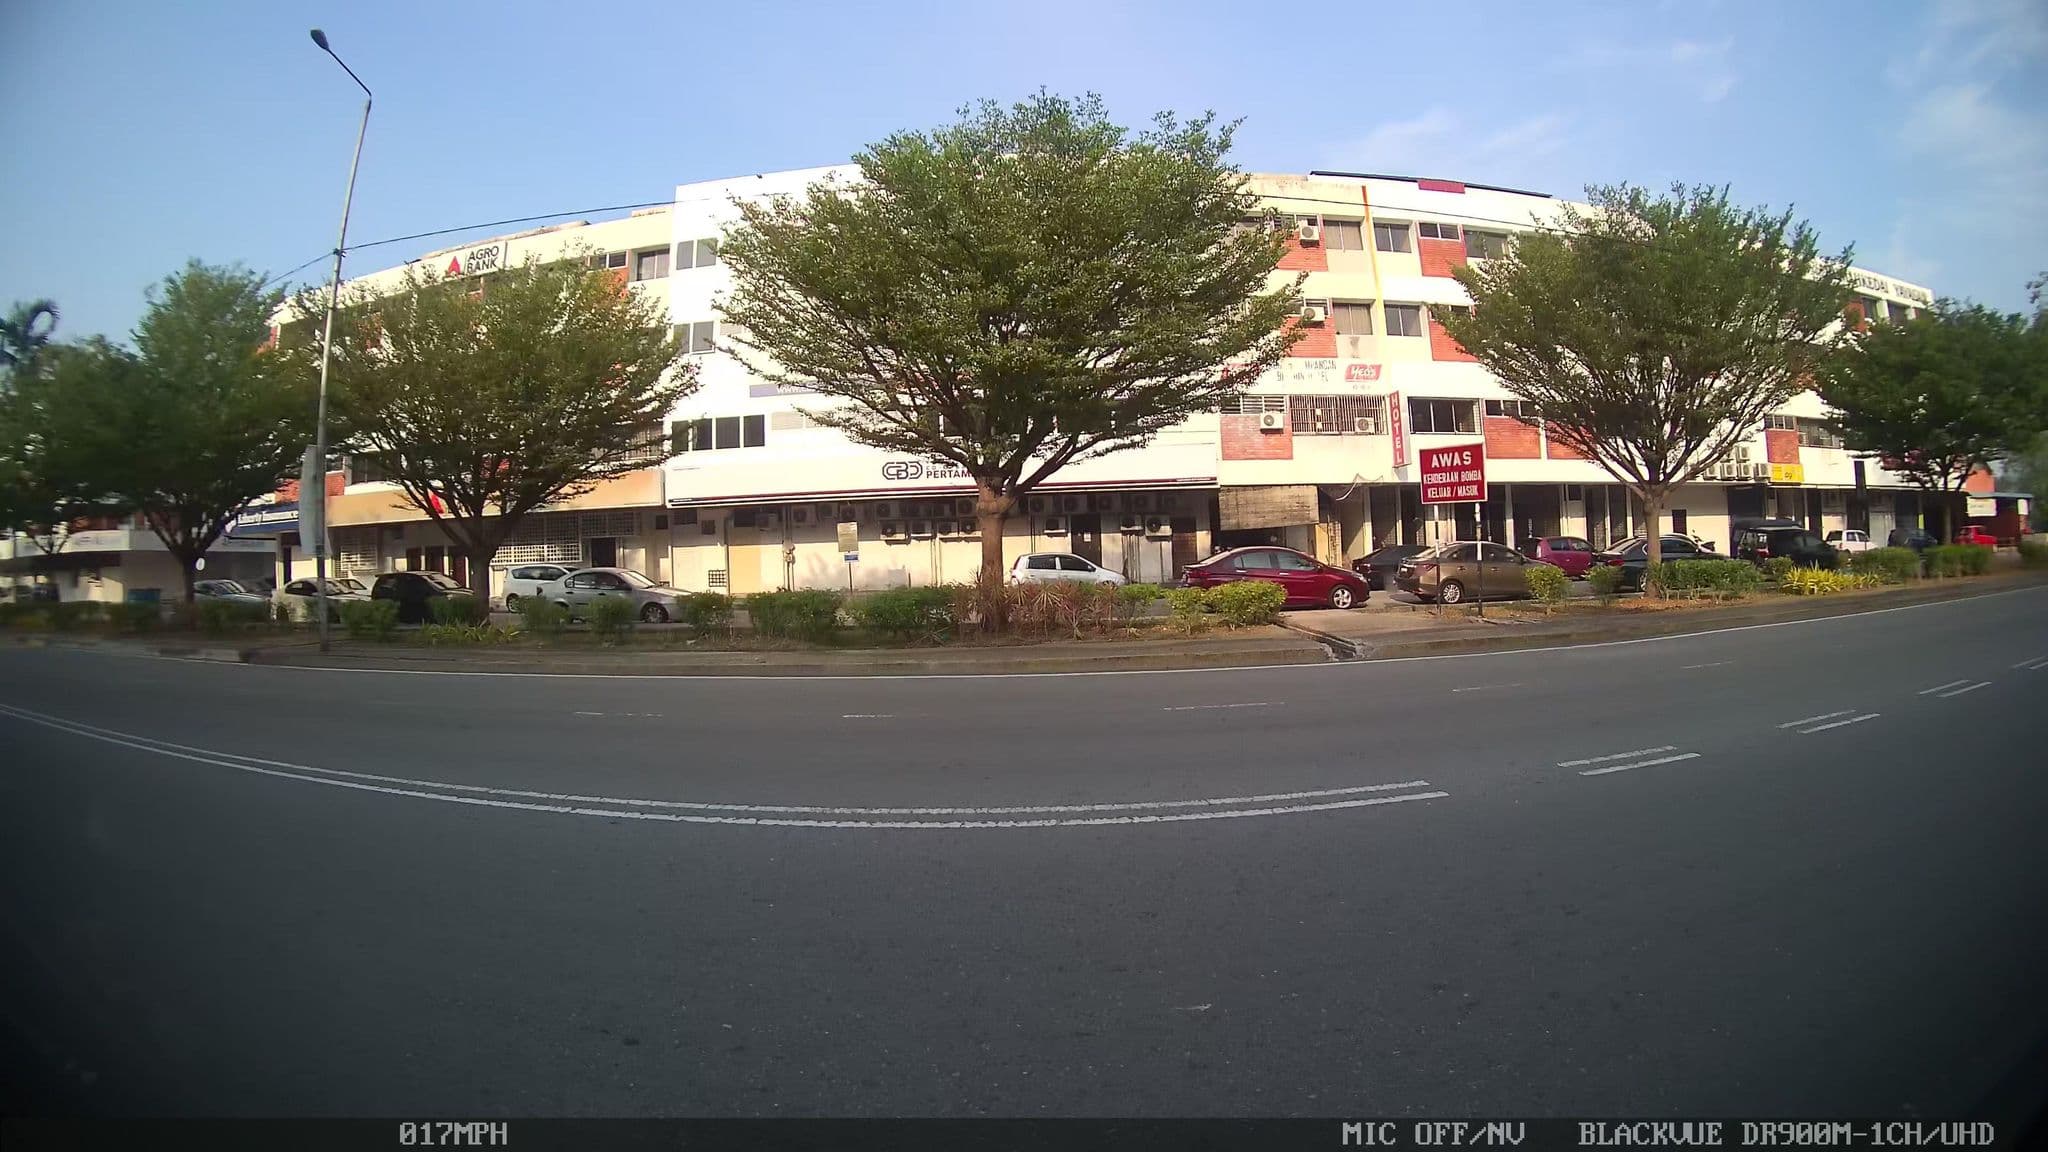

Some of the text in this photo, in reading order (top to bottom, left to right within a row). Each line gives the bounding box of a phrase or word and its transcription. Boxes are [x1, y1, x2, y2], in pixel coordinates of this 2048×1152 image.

[468, 245, 500, 261] AGRO
[466, 257, 498, 274] BANK
[1390, 393, 1403, 464] HOTEL
[1431, 451, 1472, 468] AWAS
[926, 469, 971, 479] PERTAM
[1423, 469, 1482, 485] KENDERAAN BOMBA
[1427, 487, 1452, 498] KELUAR
[1457, 485, 1479, 497] MASUK
